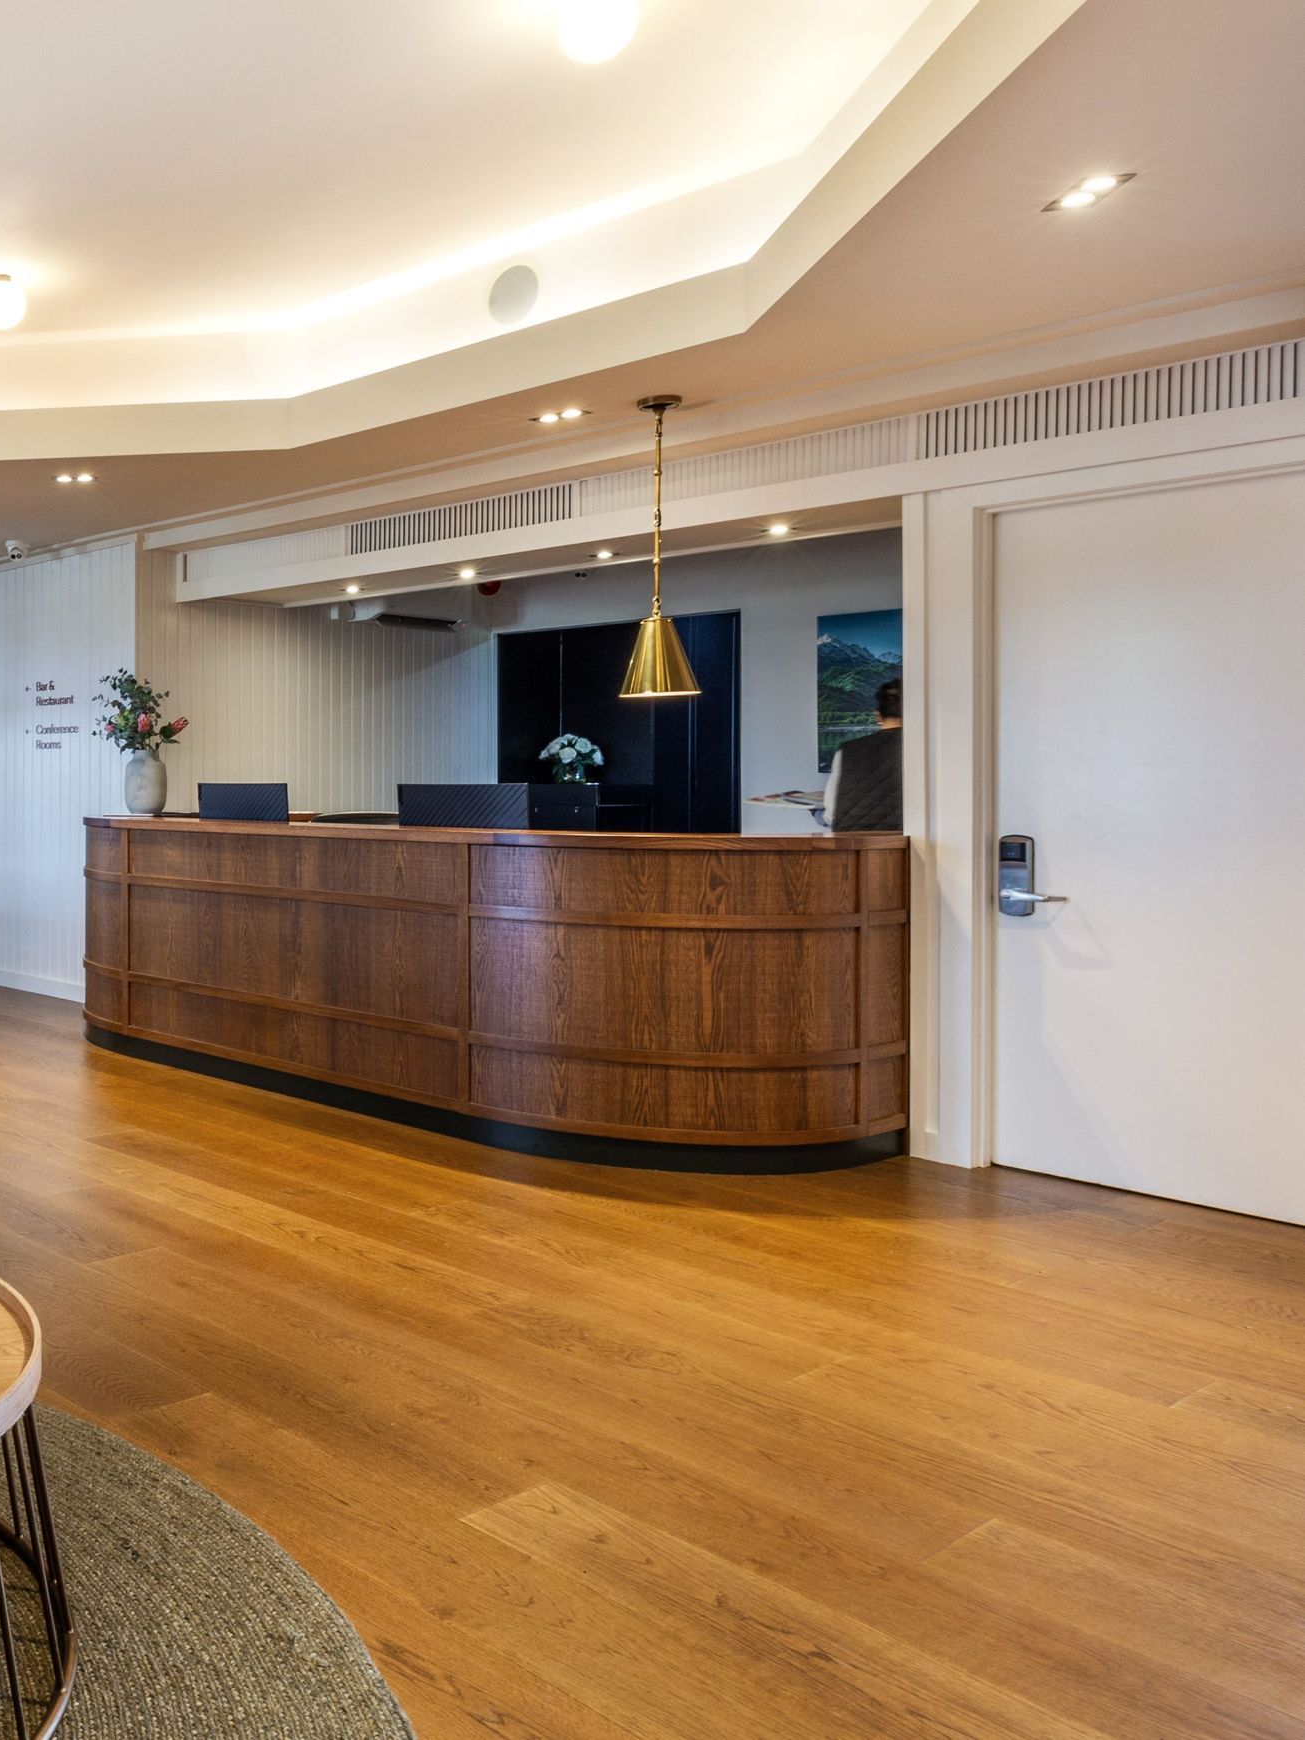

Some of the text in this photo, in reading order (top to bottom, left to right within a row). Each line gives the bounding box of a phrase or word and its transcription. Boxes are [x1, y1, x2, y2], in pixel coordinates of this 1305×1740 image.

[36, 681, 55, 692] Bar &
[36, 695, 74, 706] Restaurant
[36, 724, 79, 735] Conference
[36, 739, 62, 750] Rooms
